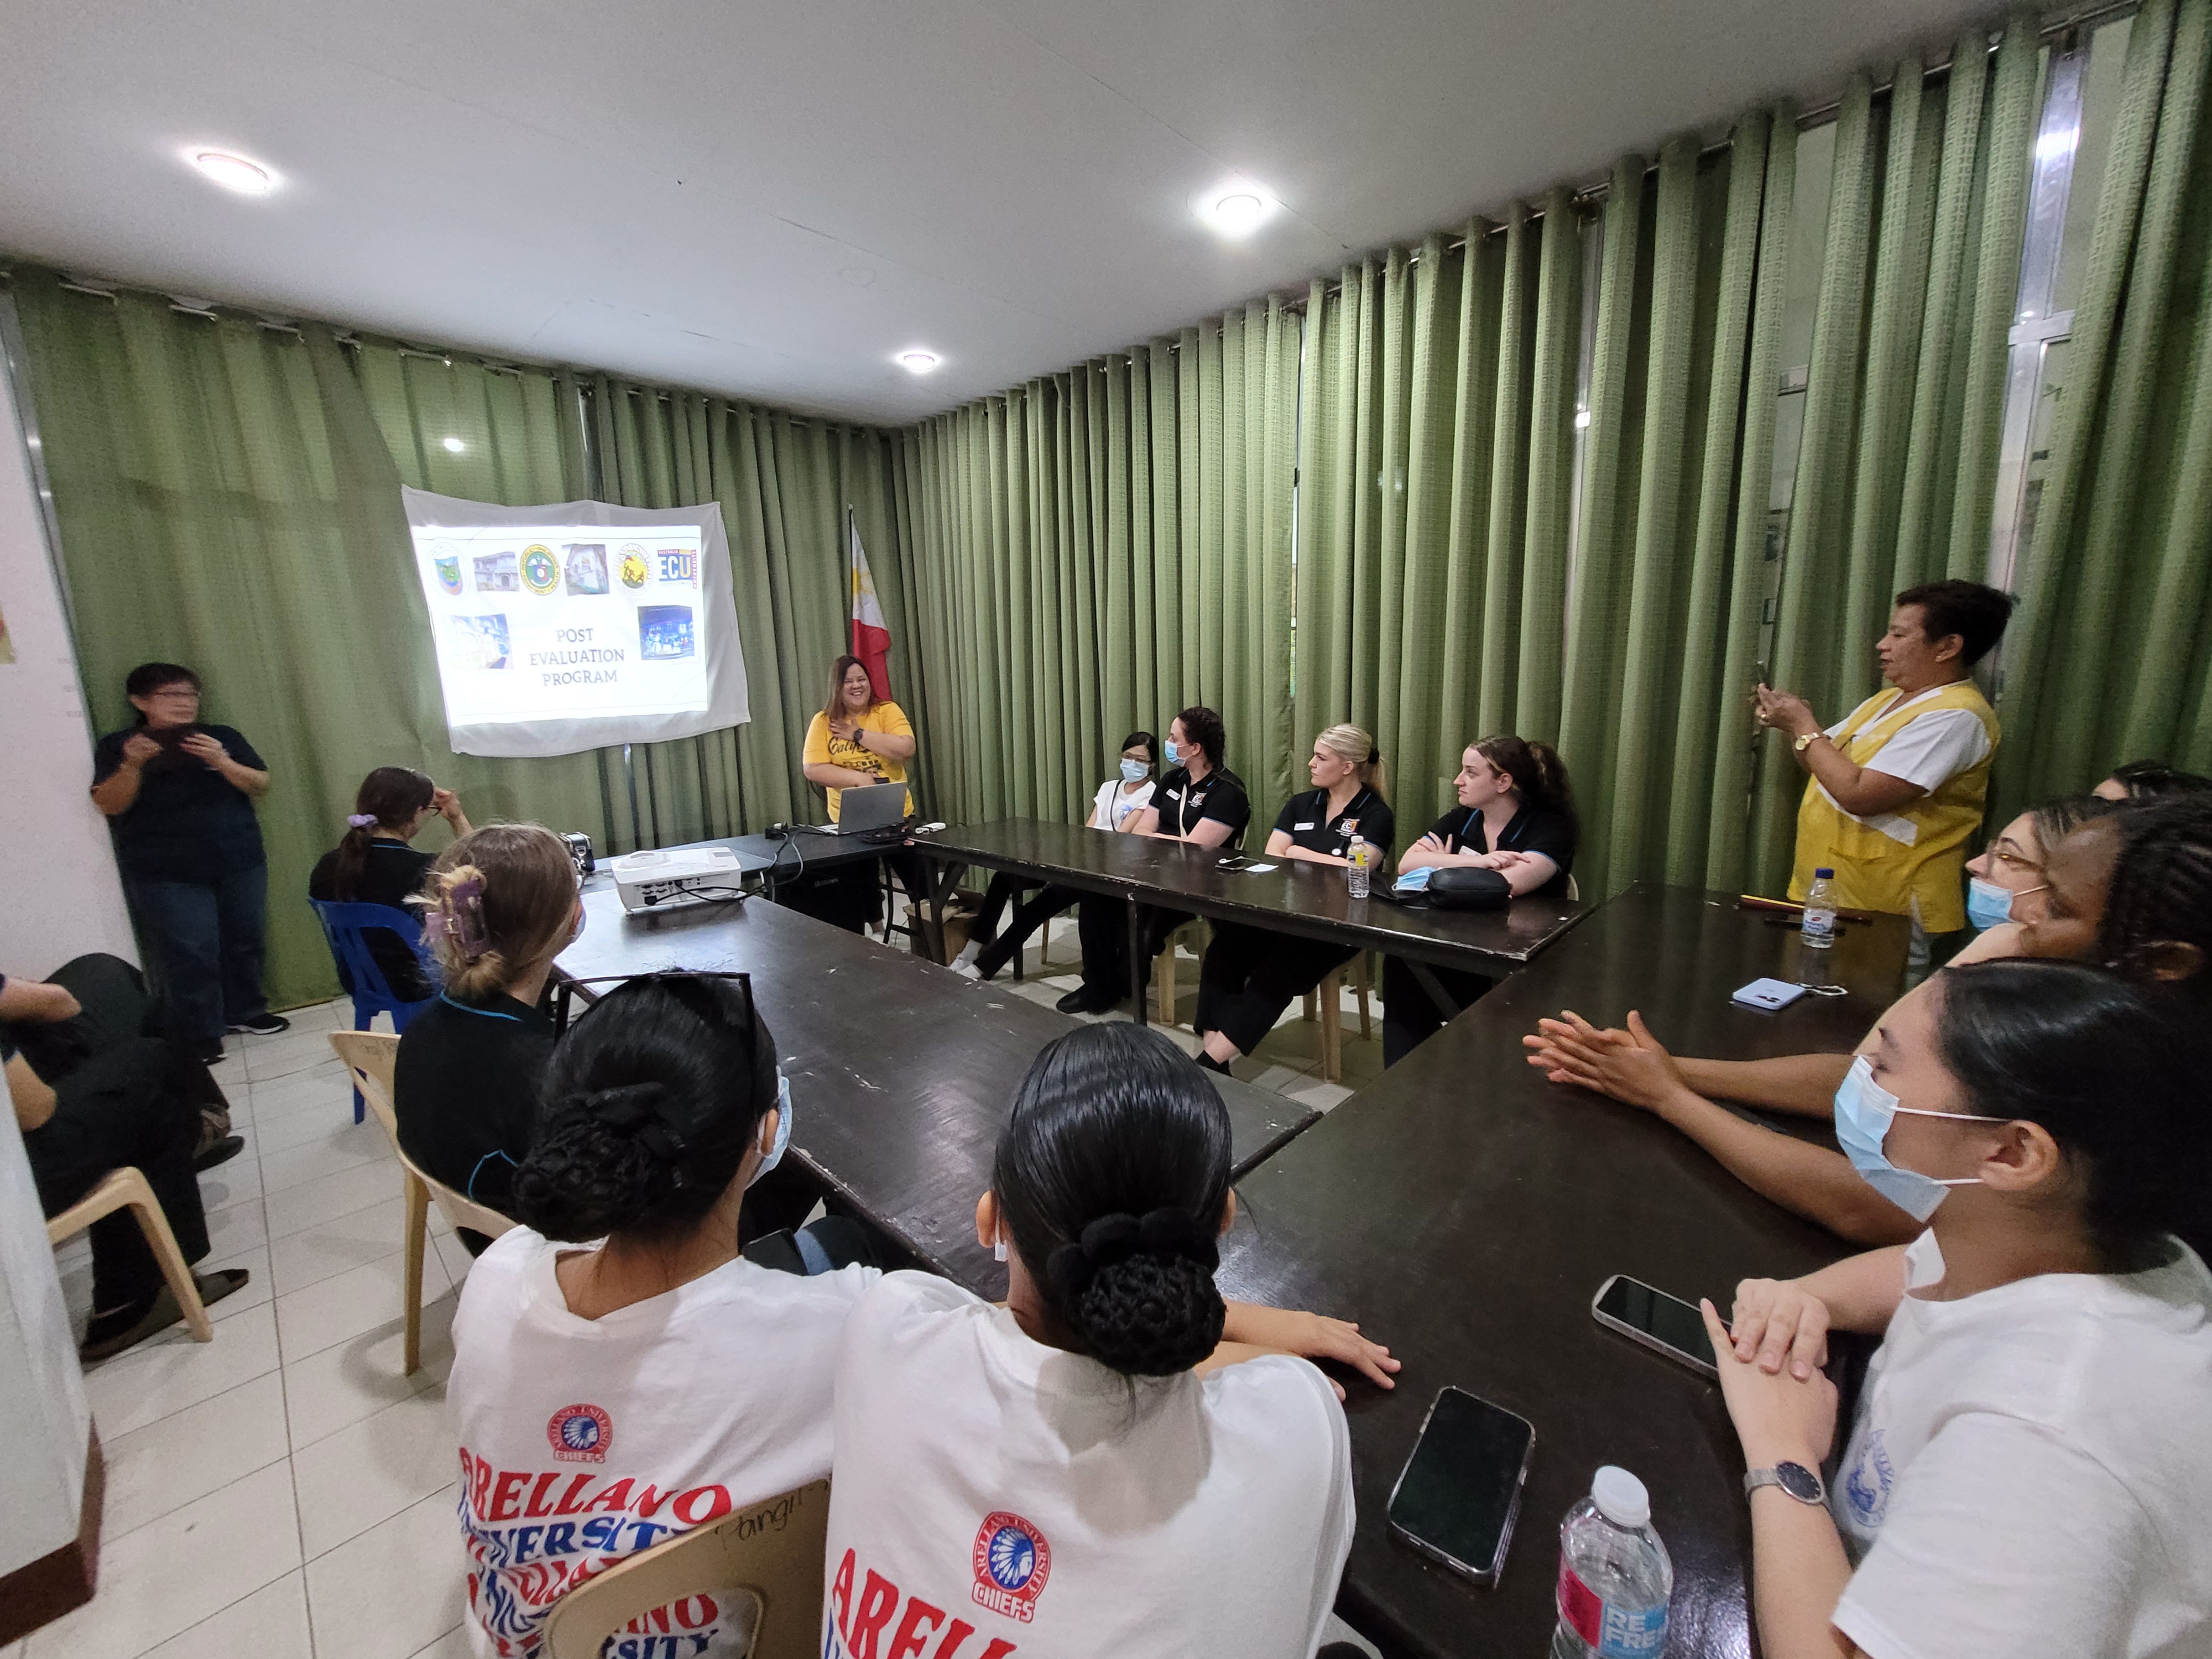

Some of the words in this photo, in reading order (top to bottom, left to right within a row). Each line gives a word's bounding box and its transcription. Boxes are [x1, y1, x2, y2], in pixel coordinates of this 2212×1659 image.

[658, 555, 691, 580] ECU
[556, 628, 593, 643] POST
[529, 649, 625, 666] EVALUATION
[541, 669, 618, 686] PROGRAM
[554, 1450, 605, 1463] CHIEFS
[459, 1447, 732, 1525] ARELLANO
[977, 1515, 1010, 1577] ARELLANO
[1014, 1518, 1047, 1593] UNIVERSITY
[972, 1581, 1035, 1623] CHIEFS
[1606, 1606, 1646, 1631] RE
